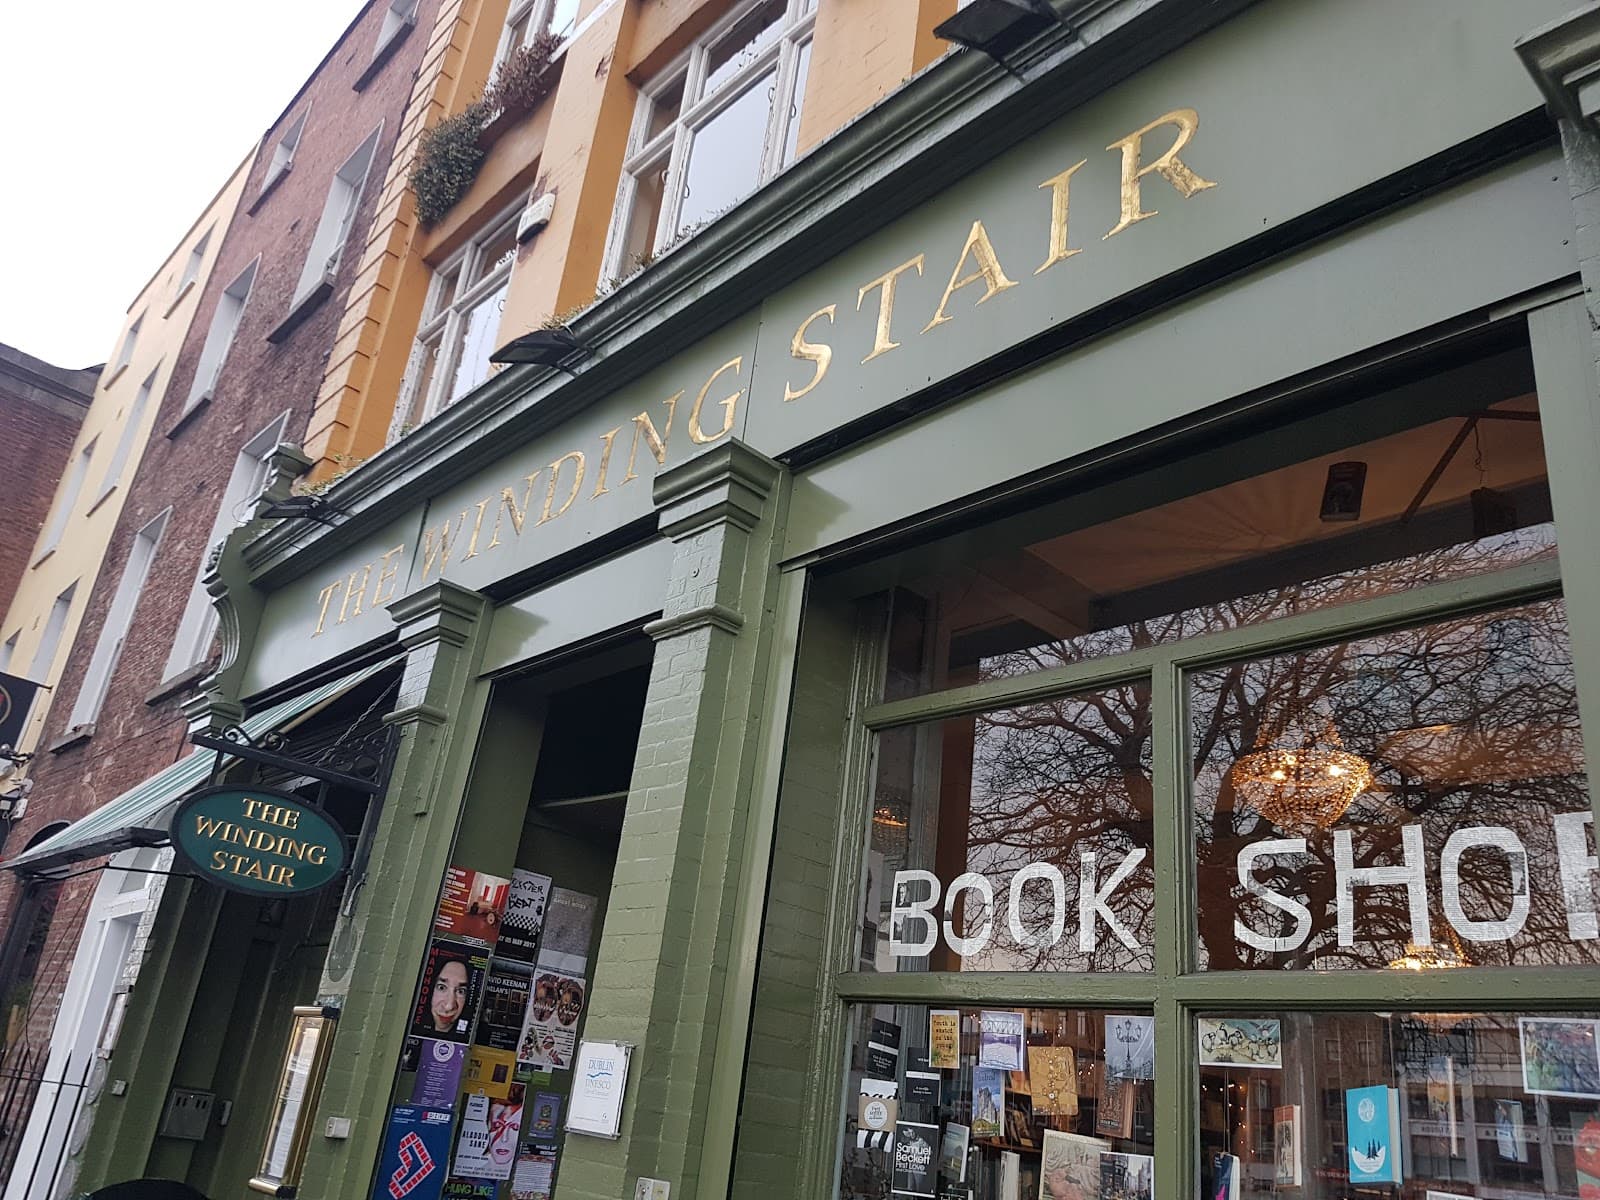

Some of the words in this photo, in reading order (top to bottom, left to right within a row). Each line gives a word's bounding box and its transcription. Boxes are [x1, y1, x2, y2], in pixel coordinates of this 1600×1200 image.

[311, 543, 404, 639] THE
[422, 355, 746, 582] WINDING
[783, 107, 1219, 402] STAIR
[242, 798, 300, 830] THE
[195, 814, 328, 865] WINDING
[210, 850, 295, 888] STAIR
[889, 847, 1148, 957] BOOK
[523, 941, 536, 949] 2017
[415, 947, 439, 1024] MADHOUSE
[487, 976, 502, 985] AVID
[502, 978, 527, 989] KEENAN
[486, 985, 508, 994] HELAN'S
[588, 1060, 615, 1071] DUBLIN
[585, 1079, 611, 1089] UNESCO
[469, 1140, 486, 1149] SANE
[896, 1142, 931, 1156] Samuel
[896, 1151, 930, 1165] Beckett
[896, 1161, 908, 1169] First
[909, 1163, 925, 1171] Love
[473, 1185, 494, 1197] LIKE
